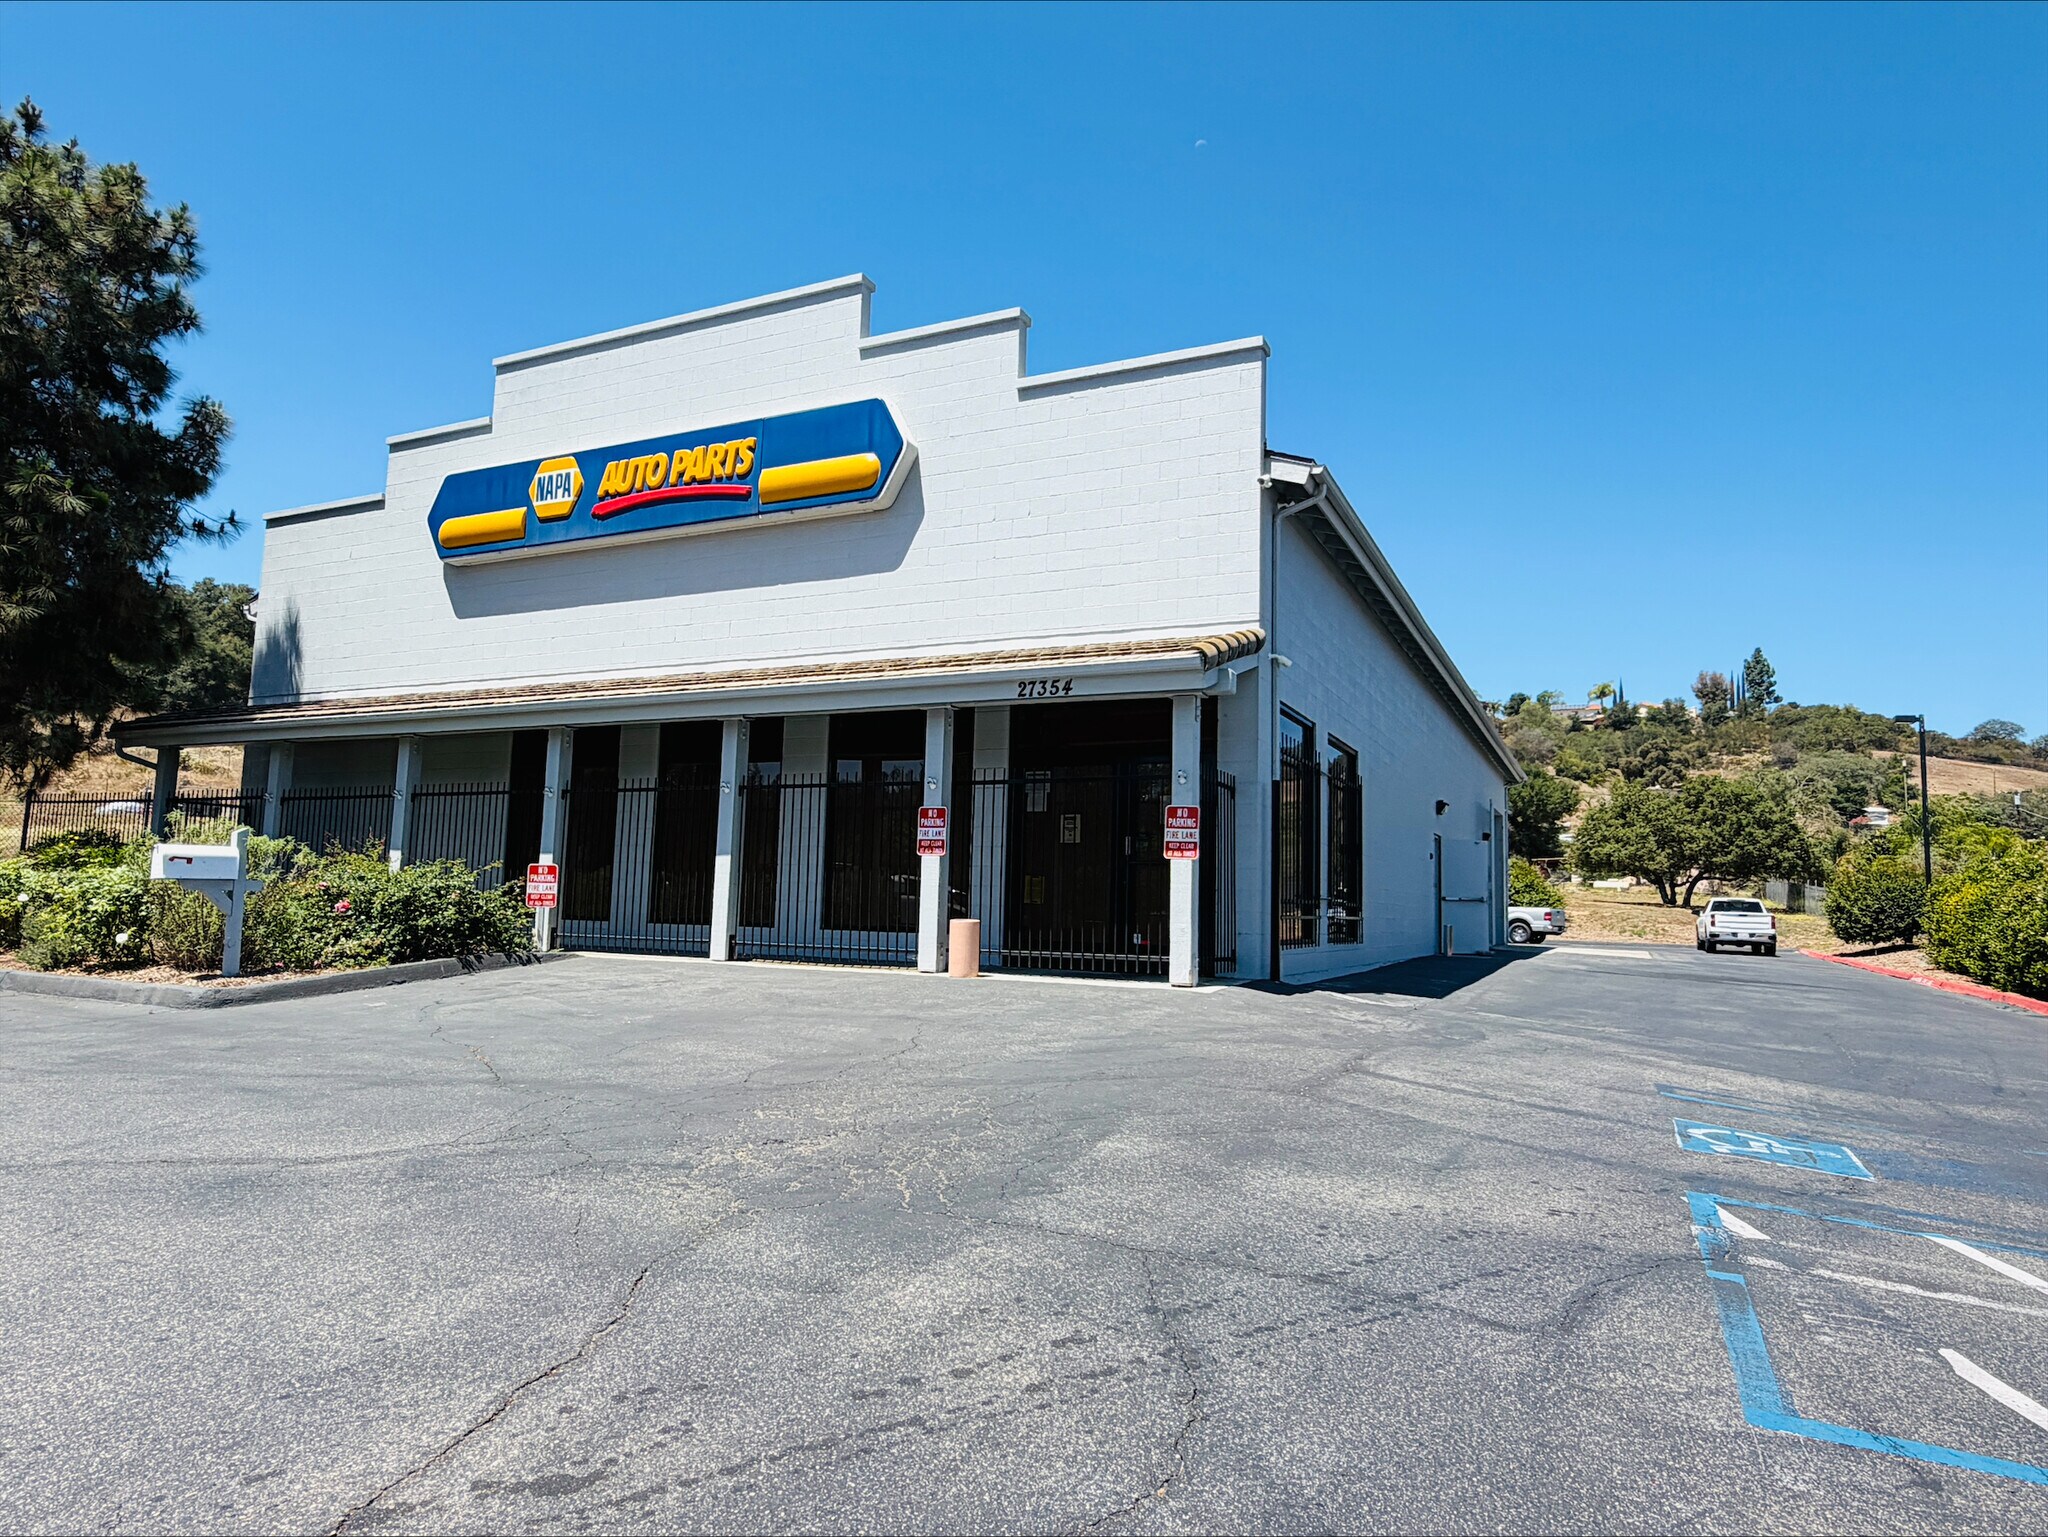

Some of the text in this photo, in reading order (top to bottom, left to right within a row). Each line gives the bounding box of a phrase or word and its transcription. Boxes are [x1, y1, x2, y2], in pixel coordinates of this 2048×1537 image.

[535, 437, 758, 503] NAPA AUTO PARTS
[1018, 678, 1073, 698] 27354
[928, 809, 938, 818] NO
[1177, 808, 1188, 818] NO
[920, 818, 945, 827] PARKING
[1168, 817, 1197, 828] PARKING
[919, 829, 945, 838] FIRE LANE
[1166, 830, 1197, 840] FIRE LANE
[538, 866, 549, 874] NO
[530, 874, 556, 882] PARKING
[528, 884, 540, 892] FIRE
